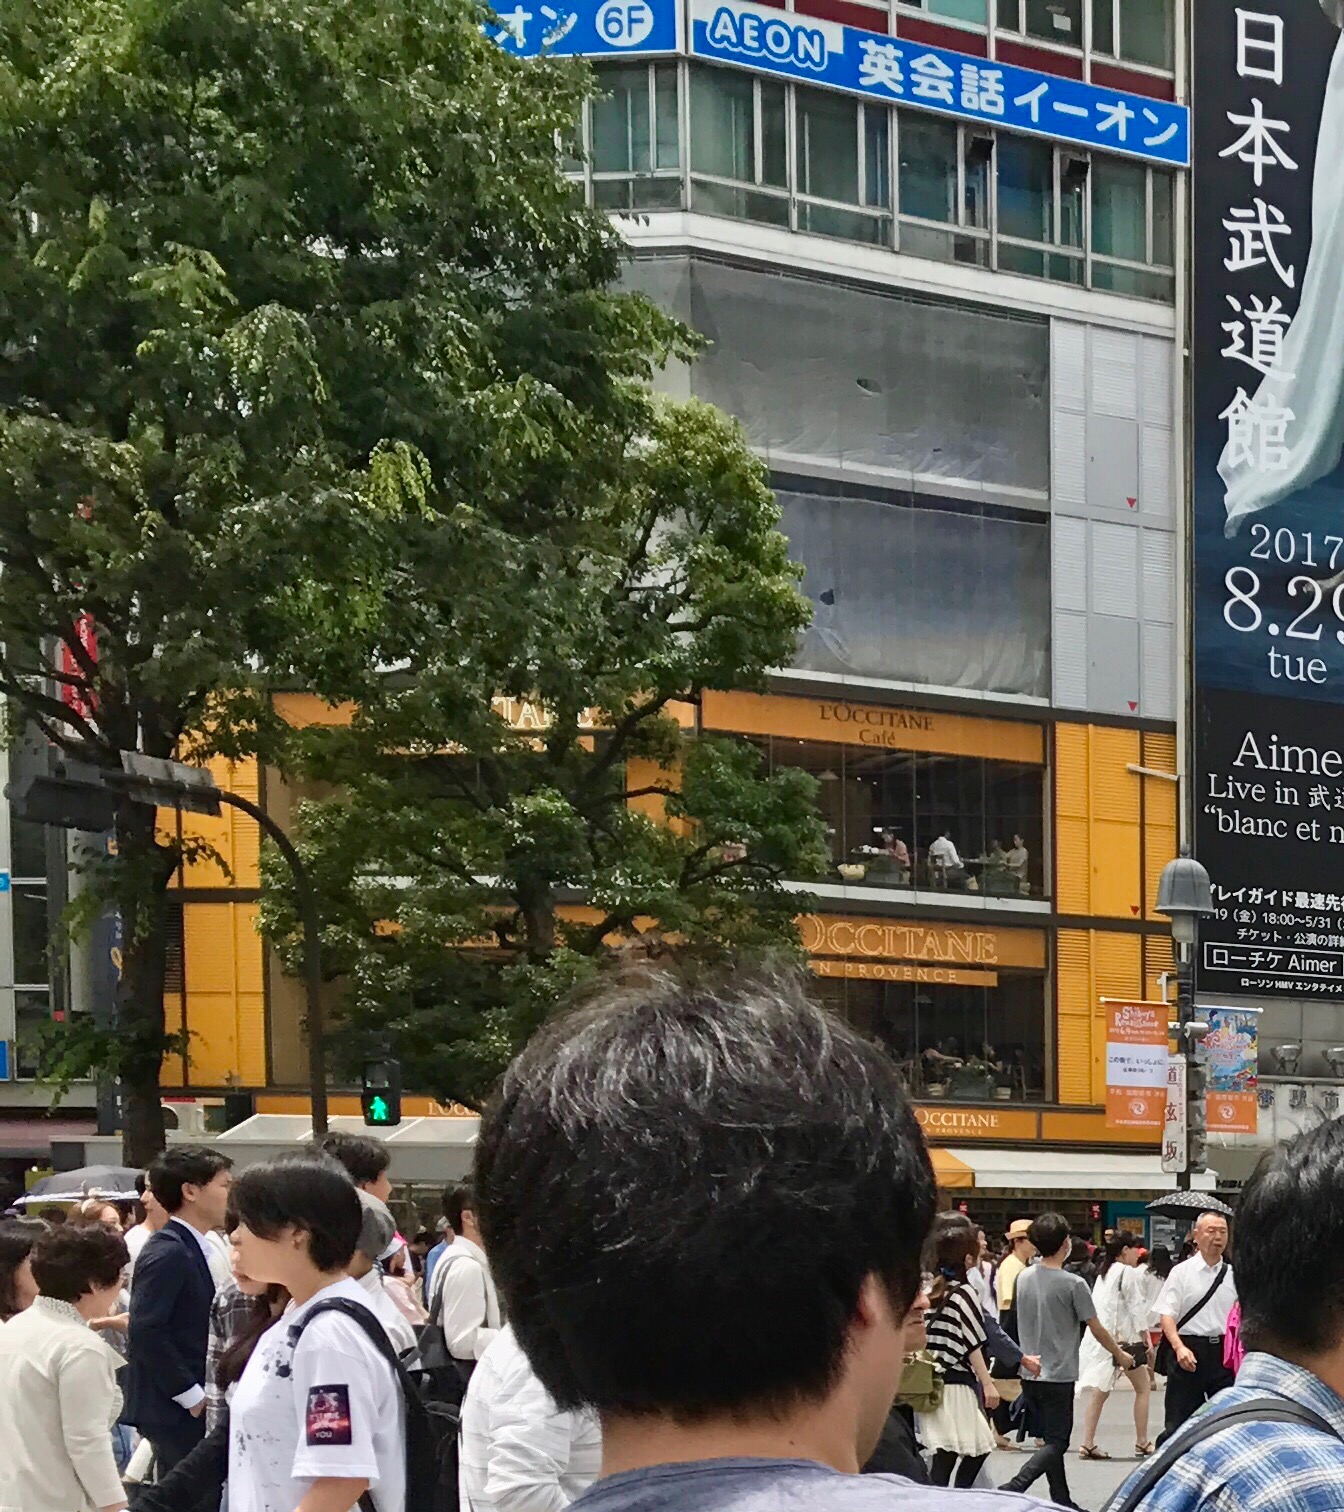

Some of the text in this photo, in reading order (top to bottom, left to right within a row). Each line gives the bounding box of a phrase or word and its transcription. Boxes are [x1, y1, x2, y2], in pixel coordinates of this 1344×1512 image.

[602, 6, 647, 38] 6F
[709, 6, 828, 68] AEON
[858, 39, 1178, 147] 英会話イーオン
[1218, 8, 1298, 472] 日本武道館
[1250, 523, 1343, 570] 2017
[1267, 646, 1328, 684] tue
[859, 727, 896, 747] Café
[1207, 773, 1265, 805] Live
[1271, 779, 1300, 806] in
[1296, 817, 1322, 842] et
[845, 963, 957, 983] PROVENCE
[1213, 949, 1283, 969] ローチケ
[1288, 953, 1337, 973] Aimer
[1241, 978, 1273, 989] ローソン
